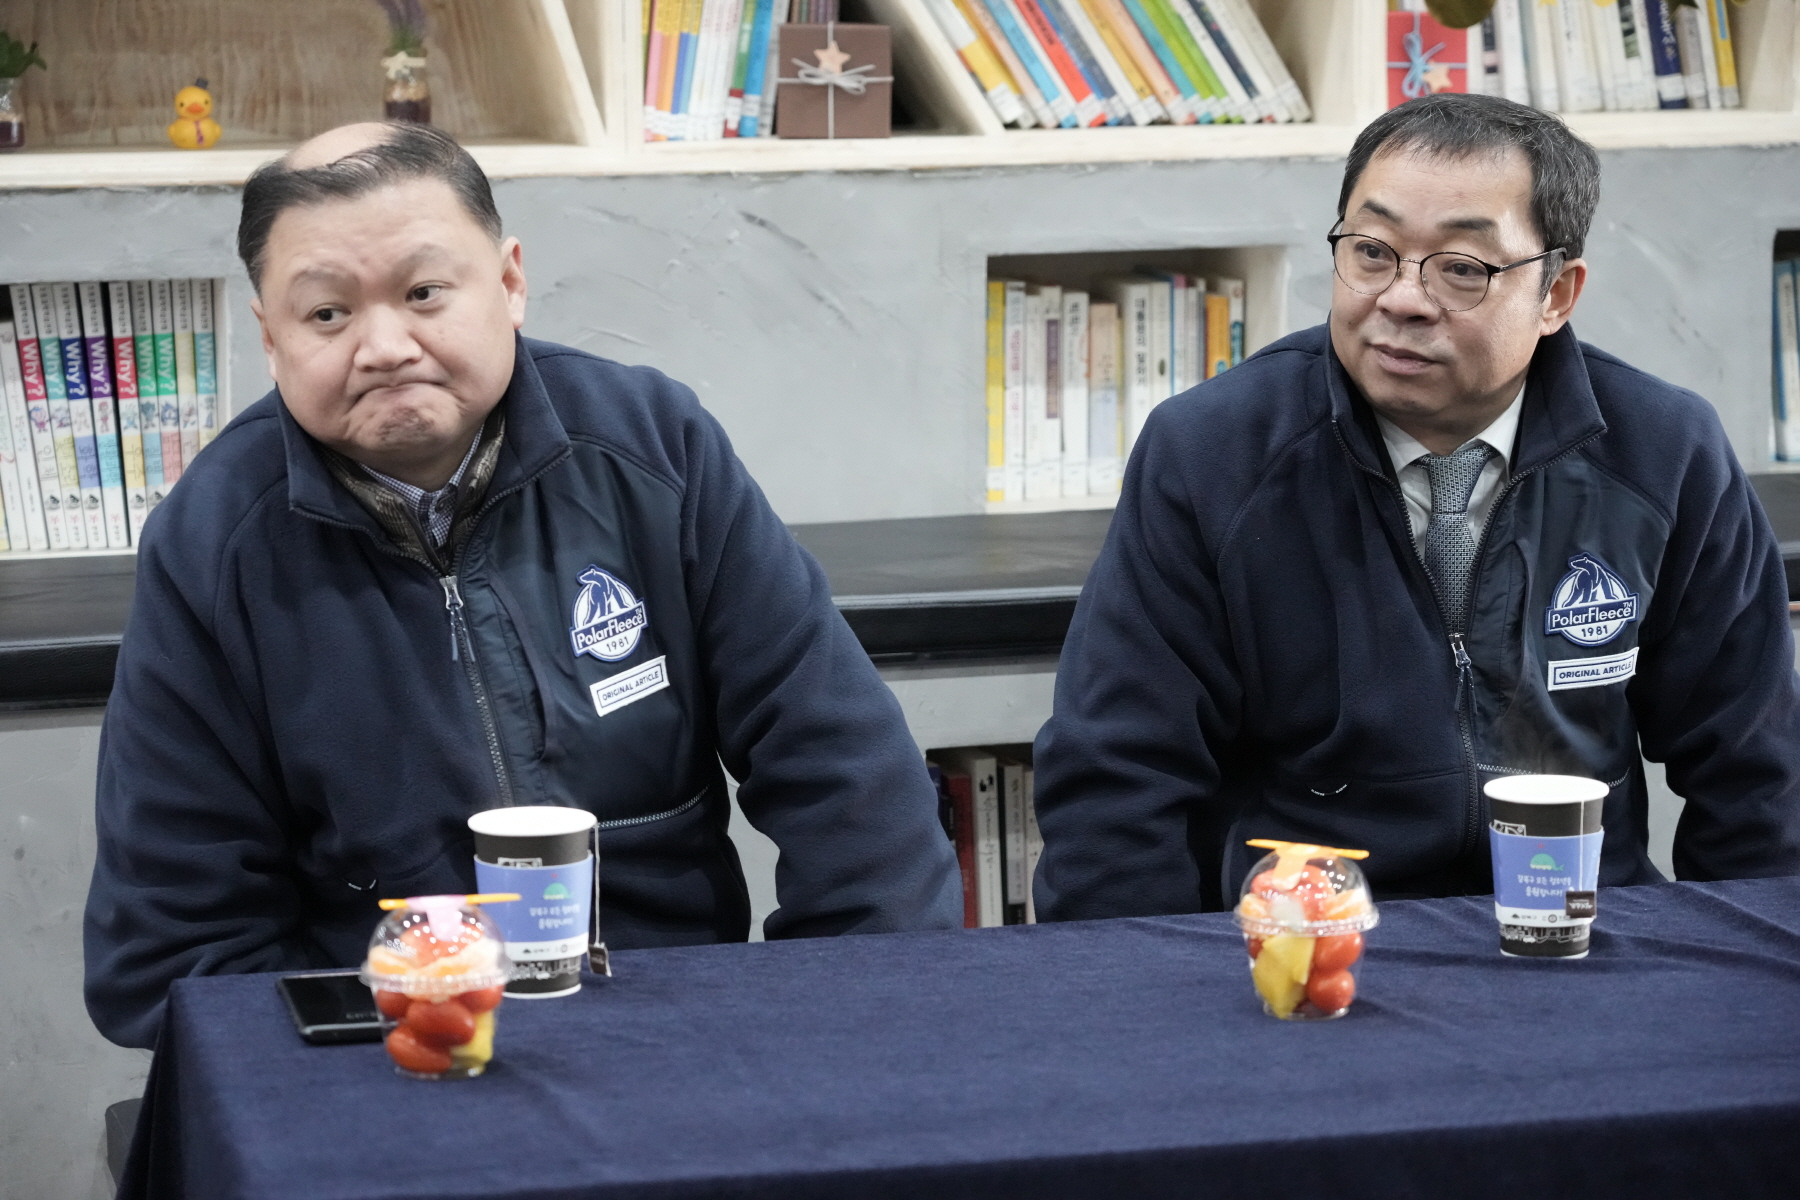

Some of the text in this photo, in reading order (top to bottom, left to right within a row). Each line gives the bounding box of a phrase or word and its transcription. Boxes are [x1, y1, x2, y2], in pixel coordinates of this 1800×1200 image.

[22, 342, 45, 397] Why?
[43, 341, 66, 397] Why?
[65, 341, 88, 397] Why?
[90, 338, 110, 396] Why?
[116, 341, 137, 397] Why?
[137, 338, 157, 393] Why?
[157, 336, 176, 393] Why?
[197, 335, 215, 391] Why?
[125, 444, 142, 481] 우주
[576, 613, 644, 649] PolarFleece
[605, 636, 630, 653] 1981
[1552, 606, 1632, 628] PolarFleece
[1581, 625, 1609, 638] 1981
[601, 670, 660, 701] ORIGINAL ARTICLE
[1558, 660, 1632, 680] ORIGINAL ARTICLE
